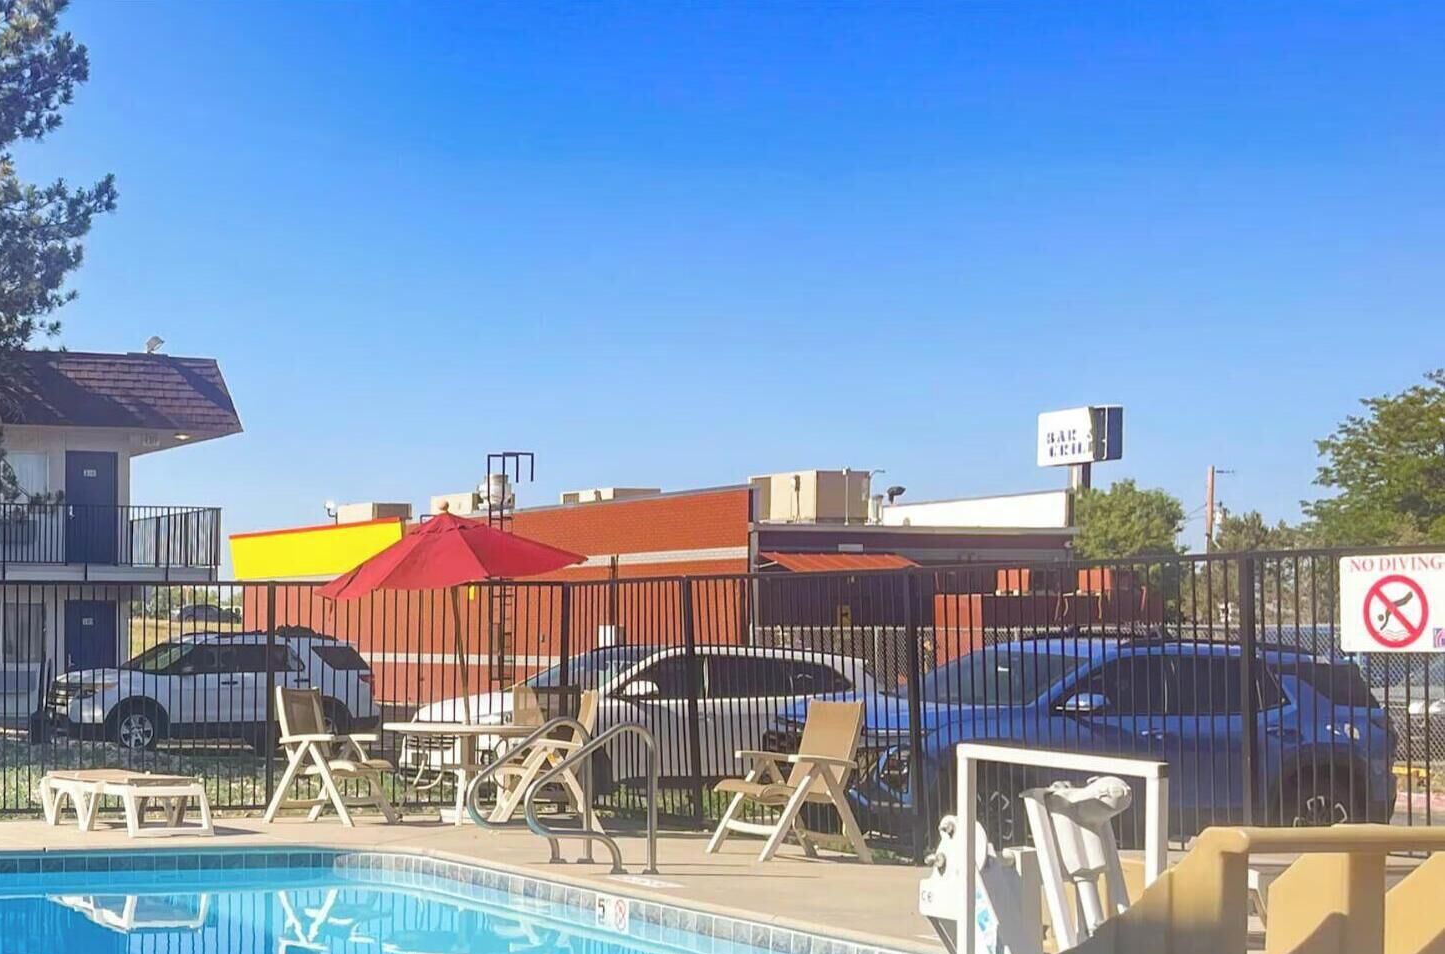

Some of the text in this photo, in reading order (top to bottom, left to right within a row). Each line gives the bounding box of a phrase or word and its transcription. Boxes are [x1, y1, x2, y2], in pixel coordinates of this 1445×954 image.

[1046, 429, 1076, 444] BAR
[1351, 556, 1442, 572] NO DIVING
